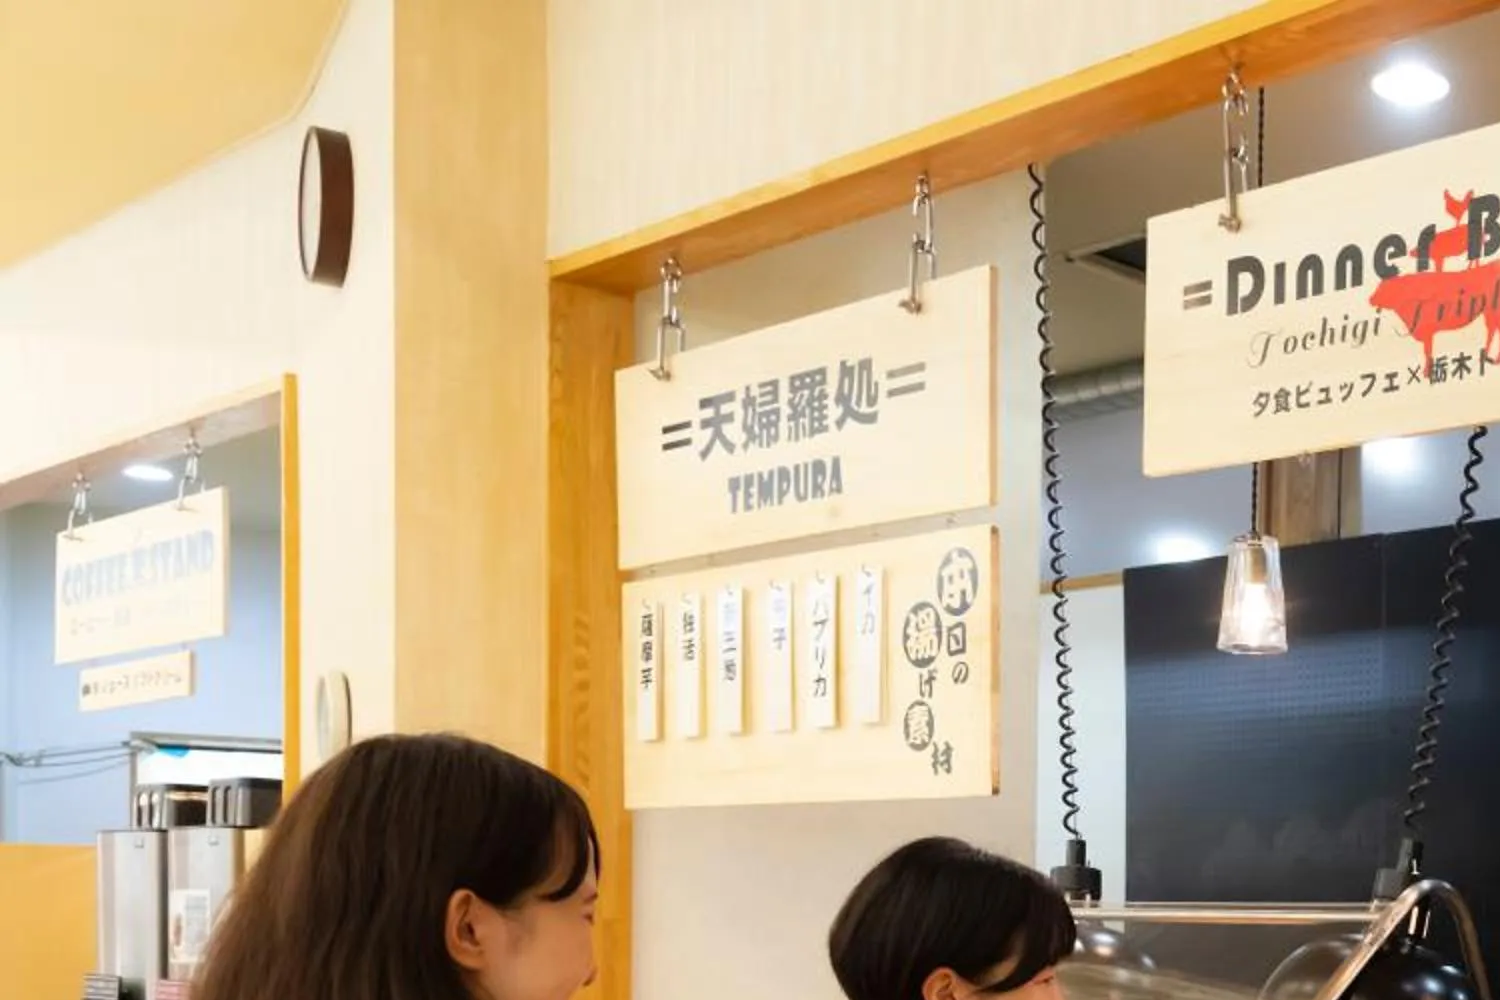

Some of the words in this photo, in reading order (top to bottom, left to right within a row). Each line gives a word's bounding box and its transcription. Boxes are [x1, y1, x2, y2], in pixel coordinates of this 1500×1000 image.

[1227, 223, 1437, 316] Dinner
[1247, 305, 1384, 369] Tochigi
[698, 357, 880, 461] 天婦羅処
[728, 456, 843, 513] TEMPURA
